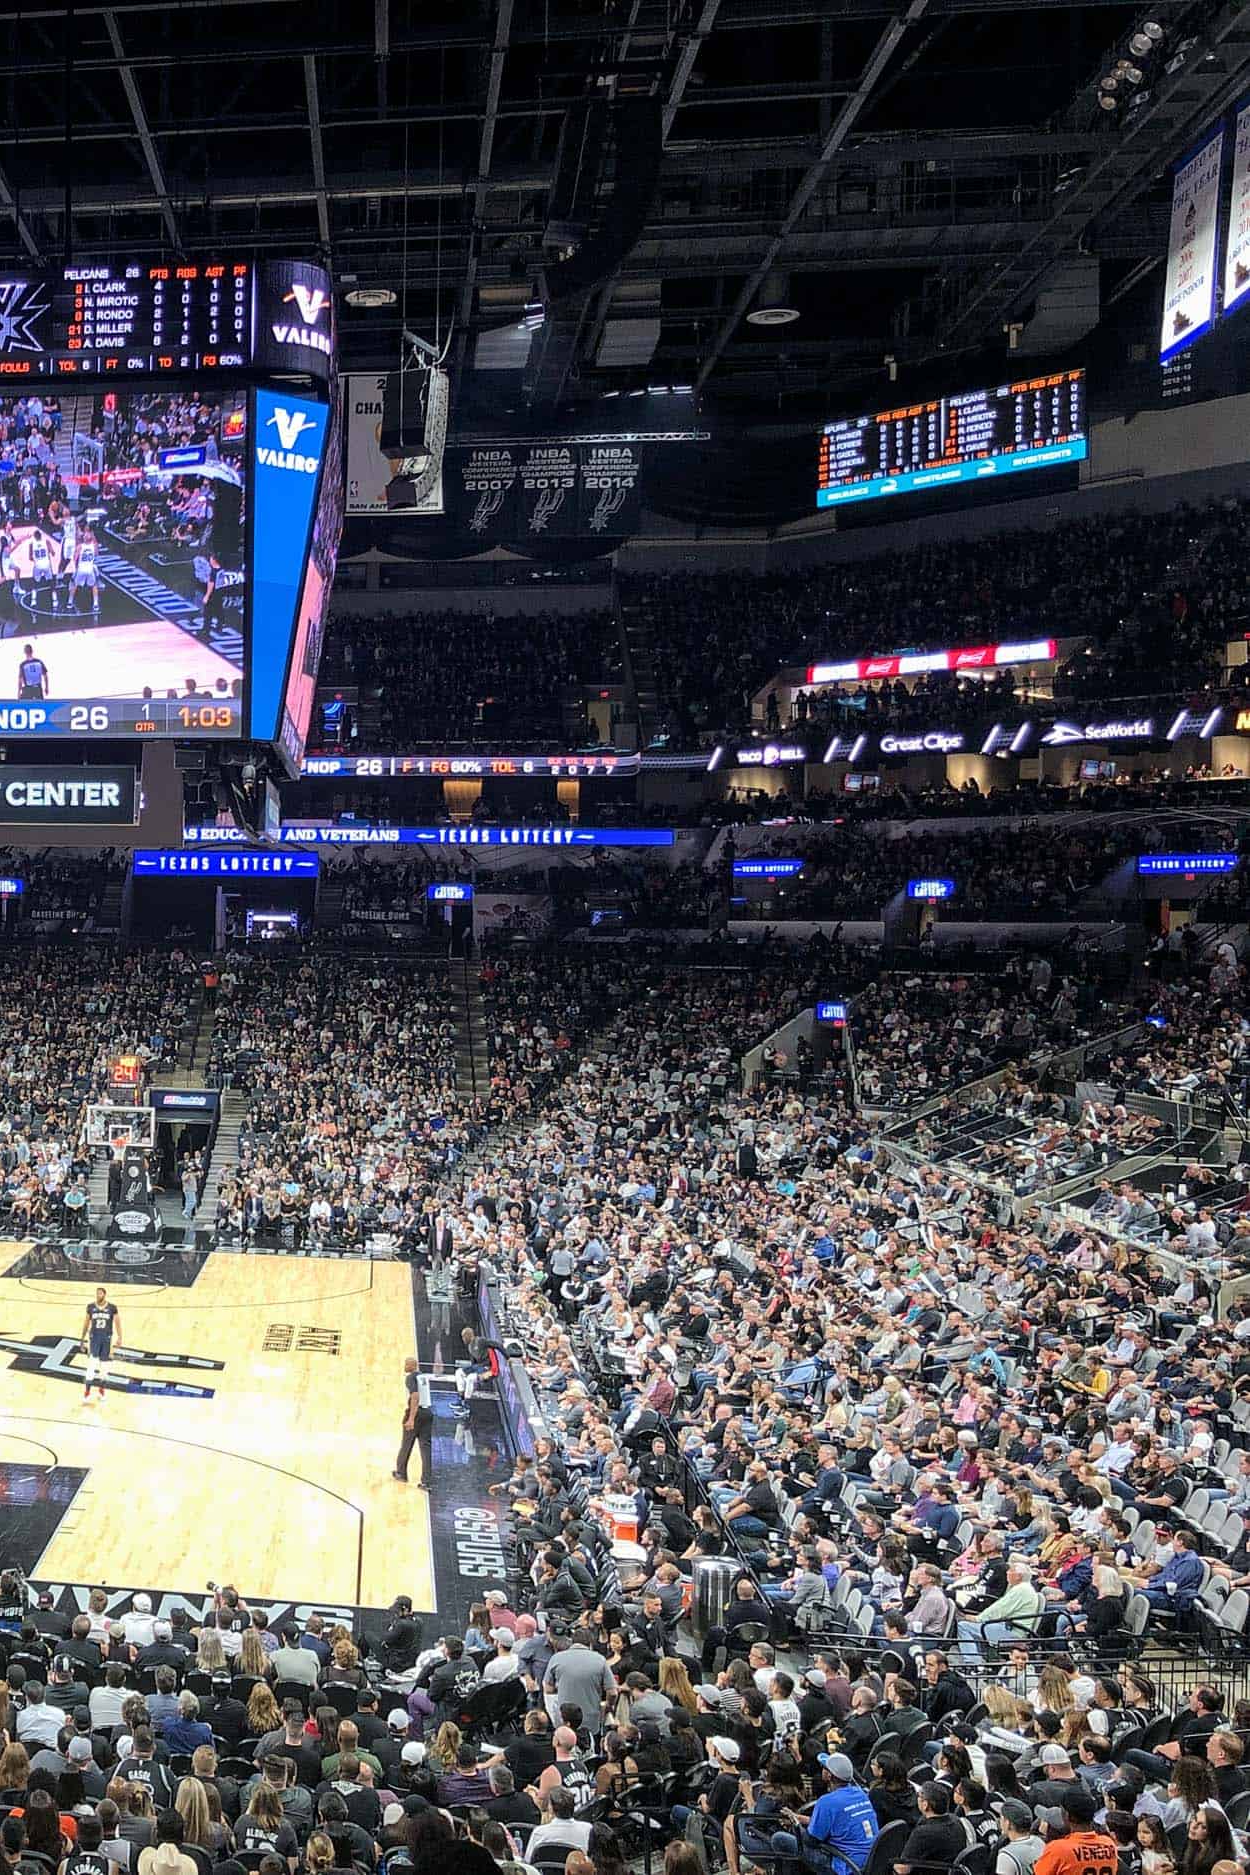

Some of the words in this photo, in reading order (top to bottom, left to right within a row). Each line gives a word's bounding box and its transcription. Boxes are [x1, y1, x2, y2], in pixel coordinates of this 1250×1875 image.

[64, 269, 109, 280] PELICANS
[125, 268, 140, 278] 26
[150, 269, 168, 279] PTS
[205, 266, 225, 277] AST
[233, 266, 246, 276] PF
[92, 282, 126, 293] CLARK
[96, 296, 138, 307] MIROTIC
[96, 310, 133, 321] RONDO
[96, 323, 132, 334] MILLER
[95, 337, 125, 348] DAVIS
[0, 362, 30, 373] FOULS
[38, 361, 44, 371] 1
[106, 359, 118, 369] FT
[127, 358, 144, 368] 0%
[158, 357, 172, 367] TO
[478, 452, 511, 460] NBA
[536, 448, 570, 458] NBA
[597, 448, 632, 457] NBA
[257, 448, 318, 473] VALERO
[462, 466, 518, 474] CONFERENCE
[465, 480, 513, 490] 2007
[524, 478, 574, 488] 2013
[585, 477, 635, 488] 2014
[70, 706, 108, 730] 26
[140, 704, 150, 720] 1
[178, 706, 232, 727] 1:03
[135, 722, 156, 732] QTR
[1085, 721, 1150, 739] SeaWorld
[880, 735, 924, 753] Great
[924, 734, 960, 752] Clips
[737, 752, 762, 763] TACO
[779, 749, 805, 760] BELL
[307, 763, 340, 774] NOP
[356, 760, 383, 775] 26
[402, 762, 411, 772] F
[417, 762, 424, 772] 1
[431, 762, 448, 772] FG
[451, 761, 482, 772] 60%
[491, 762, 515, 772] TOL
[523, 761, 533, 773] 6
[551, 765, 559, 774] 2
[568, 766, 576, 774] 0
[587, 765, 594, 774] 7
[606, 765, 614, 774] 7
[5, 782, 120, 806] CENTER
[285, 829, 316, 840] AND
[320, 829, 399, 841] VETERANS
[439, 829, 490, 843] TEXAS
[500, 830, 574, 843] LOTTERY
[159, 857, 210, 870] TEXAS
[220, 857, 293, 870] LOTTERY
[1152, 861, 1179, 869] TEXAS
[1185, 860, 1225, 869] LOTTERY
[114, 1066, 134, 1081] 24
[453, 1507, 507, 1577] @SPURS
[1072, 1845, 1116, 1862] VENDOR
